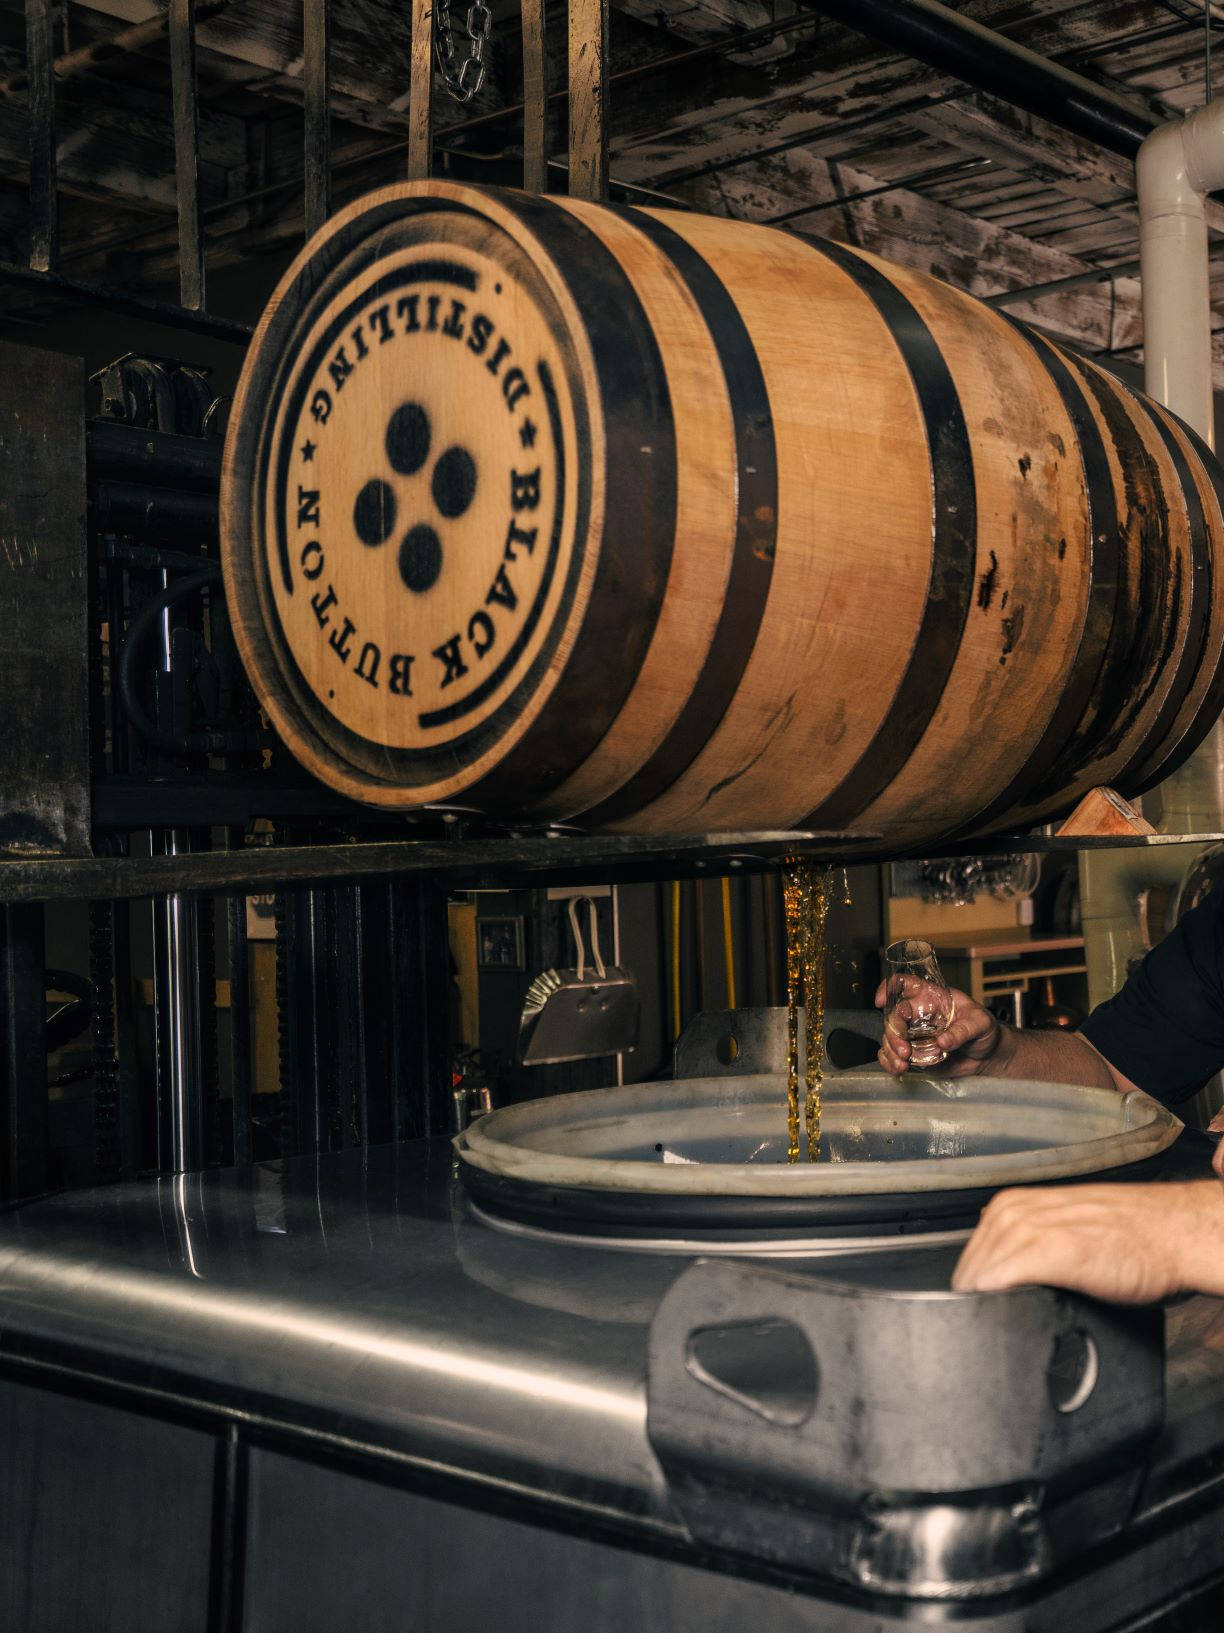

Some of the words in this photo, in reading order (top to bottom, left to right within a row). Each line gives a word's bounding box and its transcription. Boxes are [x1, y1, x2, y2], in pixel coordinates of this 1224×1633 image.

[313, 293, 532, 426] DISTILLING
[296, 484, 416, 697] BUTTON
[431, 467, 544, 689] BLACK
